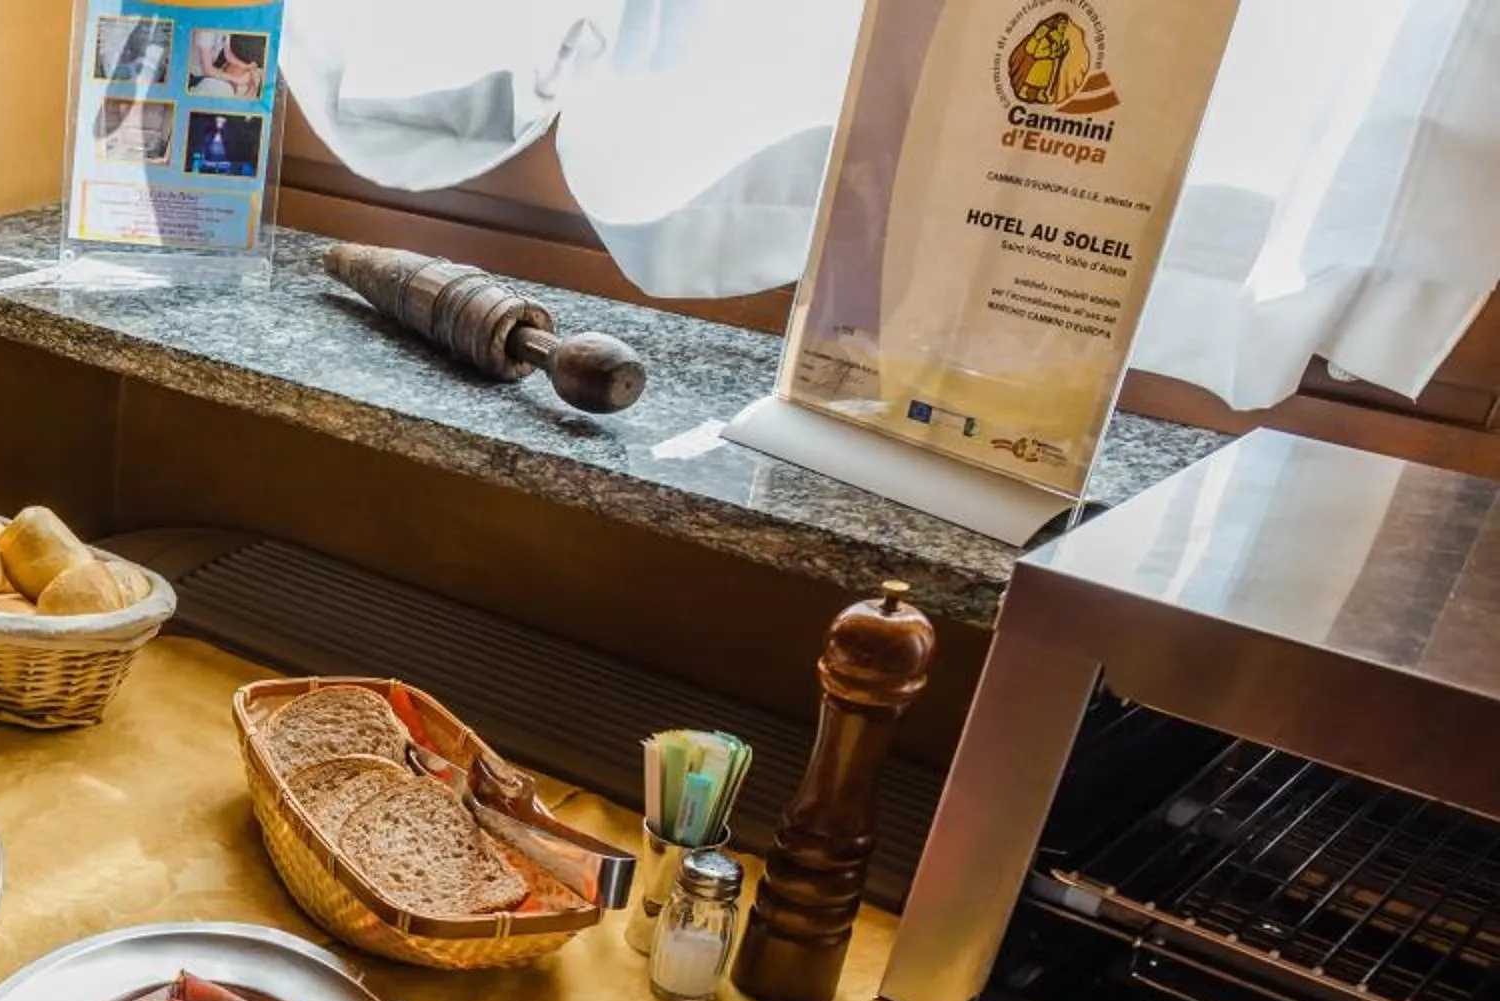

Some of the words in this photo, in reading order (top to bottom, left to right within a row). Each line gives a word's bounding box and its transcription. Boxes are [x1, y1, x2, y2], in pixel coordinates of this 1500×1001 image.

[1008, 105, 1115, 142] Cammini
[1001, 128, 1107, 164] d'Europa
[966, 208, 1025, 236] HOTEL
[1030, 223, 1059, 243] AU
[1063, 231, 1133, 260] SOLEIL
[1001, 239, 1025, 255] Saint
